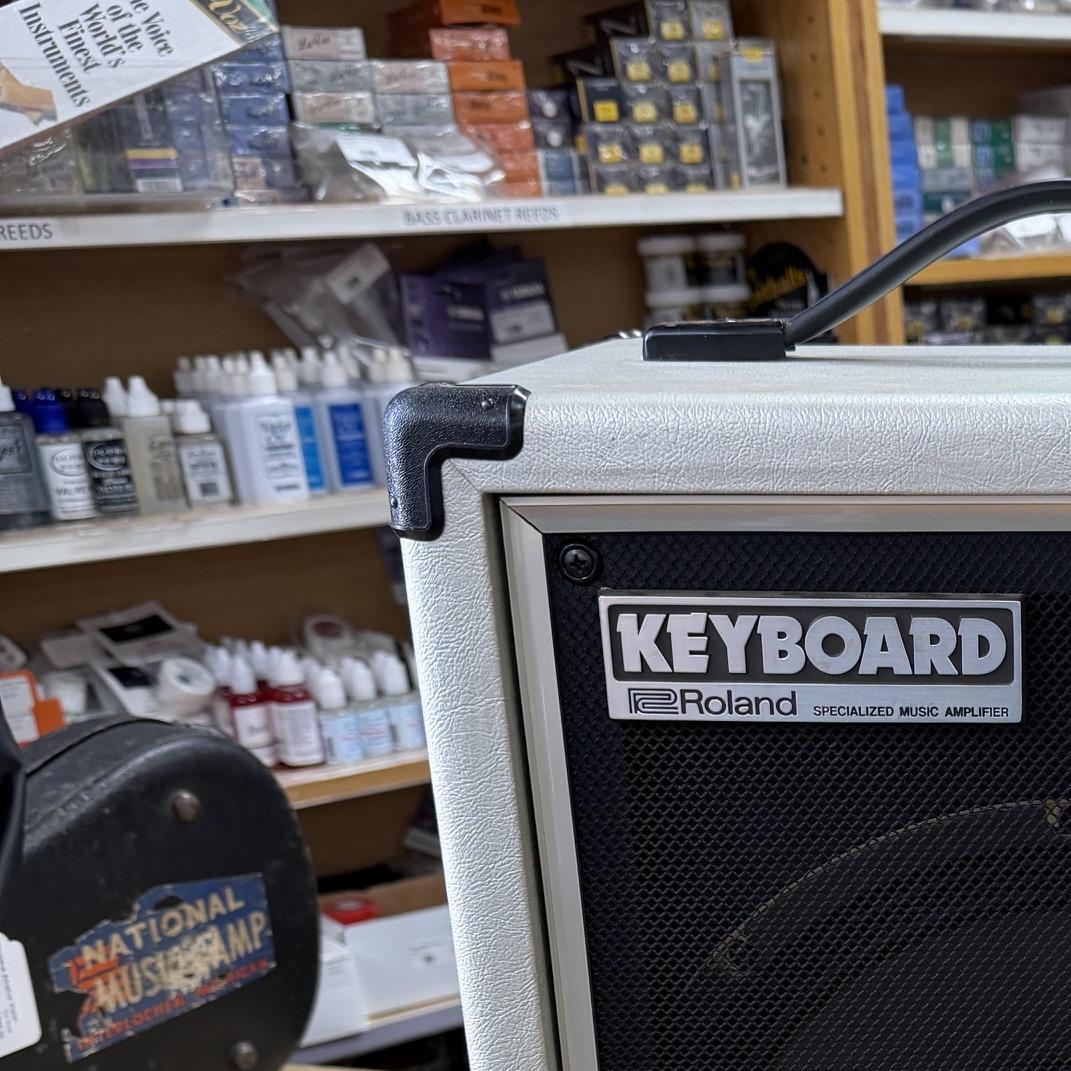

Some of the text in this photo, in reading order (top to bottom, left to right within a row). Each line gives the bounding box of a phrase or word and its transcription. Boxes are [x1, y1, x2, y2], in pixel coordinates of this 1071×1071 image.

[80, 3, 126, 68] World's
[106, 4, 133, 25] of
[118, 19, 144, 52] the
[142, 12, 174, 57] Voice
[18, 3, 91, 108] Instruments
[58, 19, 100, 74] Finest
[0, 223, 53, 241] REEDS
[402, 208, 441, 226] BASS
[442, 206, 512, 225] CLARINET
[616, 612, 1007, 677] KEYBOARD
[680, 688, 798, 717] Roland
[813, 704, 1009, 719] SPECIALIZED MUSIC AMPLIFIER
[82, 886, 246, 968] NATIONAL
[93, 944, 178, 1014] MUSI
[186, 910, 266, 980] AMP
